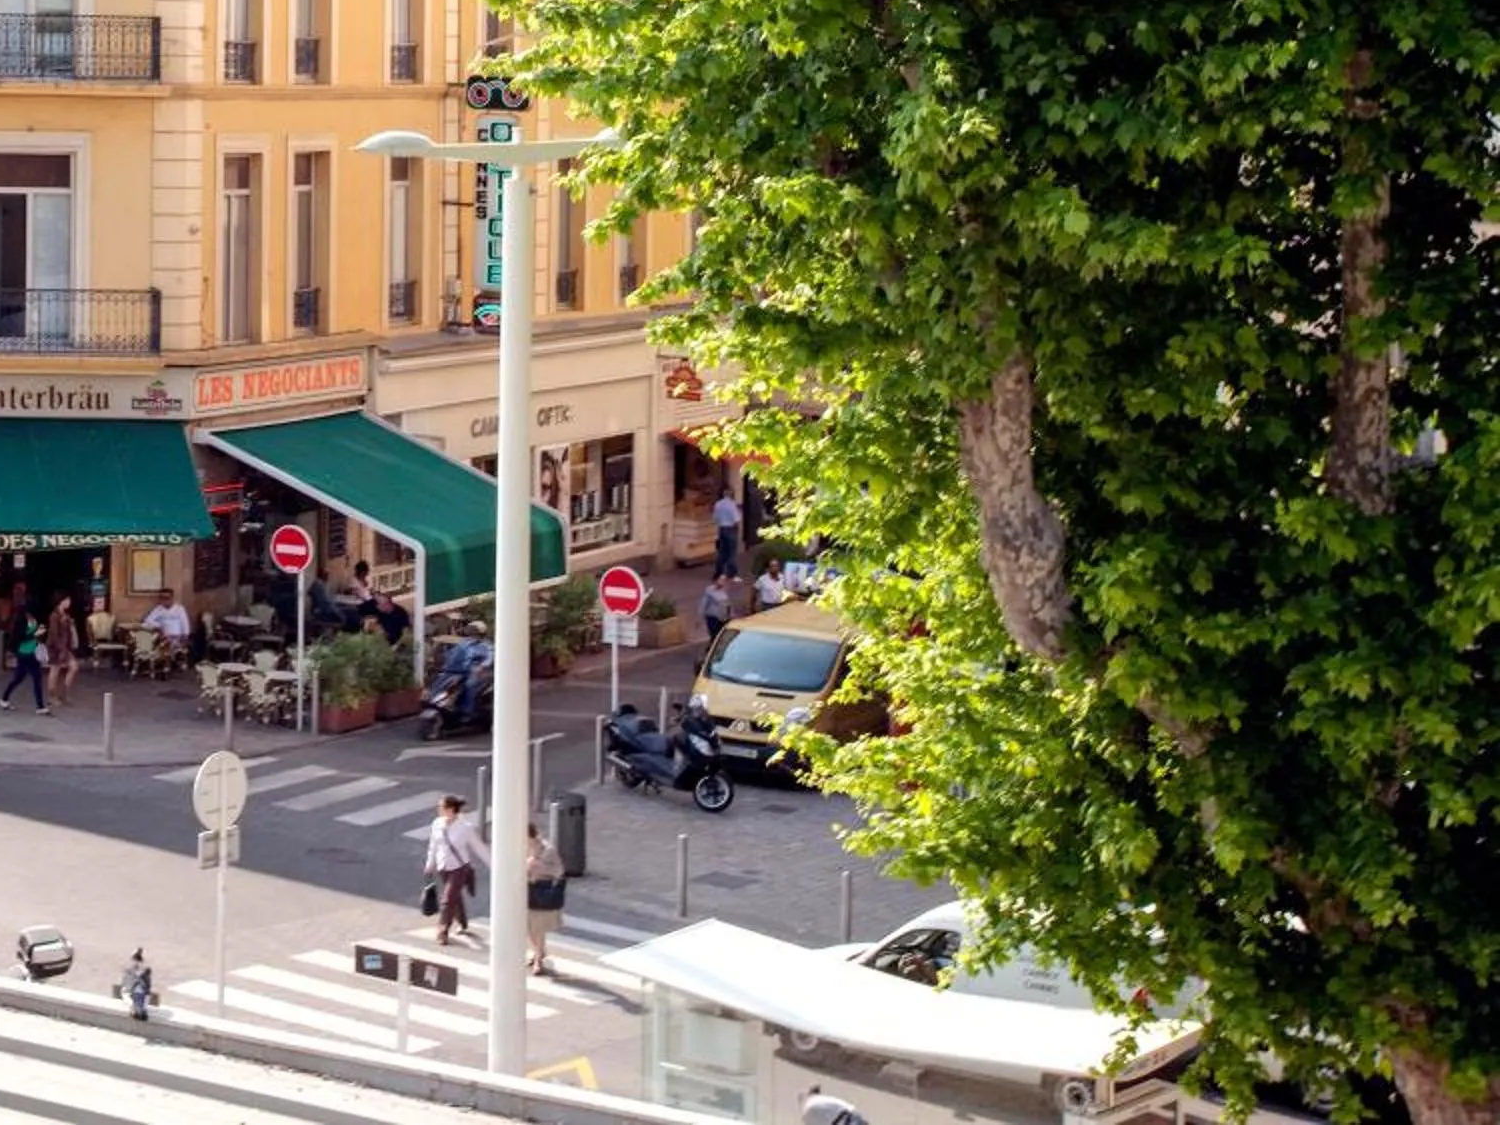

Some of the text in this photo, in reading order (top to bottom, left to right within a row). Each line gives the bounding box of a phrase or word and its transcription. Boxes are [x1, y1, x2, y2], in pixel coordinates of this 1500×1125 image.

[475, 128, 489, 220] CNNES
[196, 376, 233, 406] LES
[242, 357, 361, 400] NEGOCIANTS
